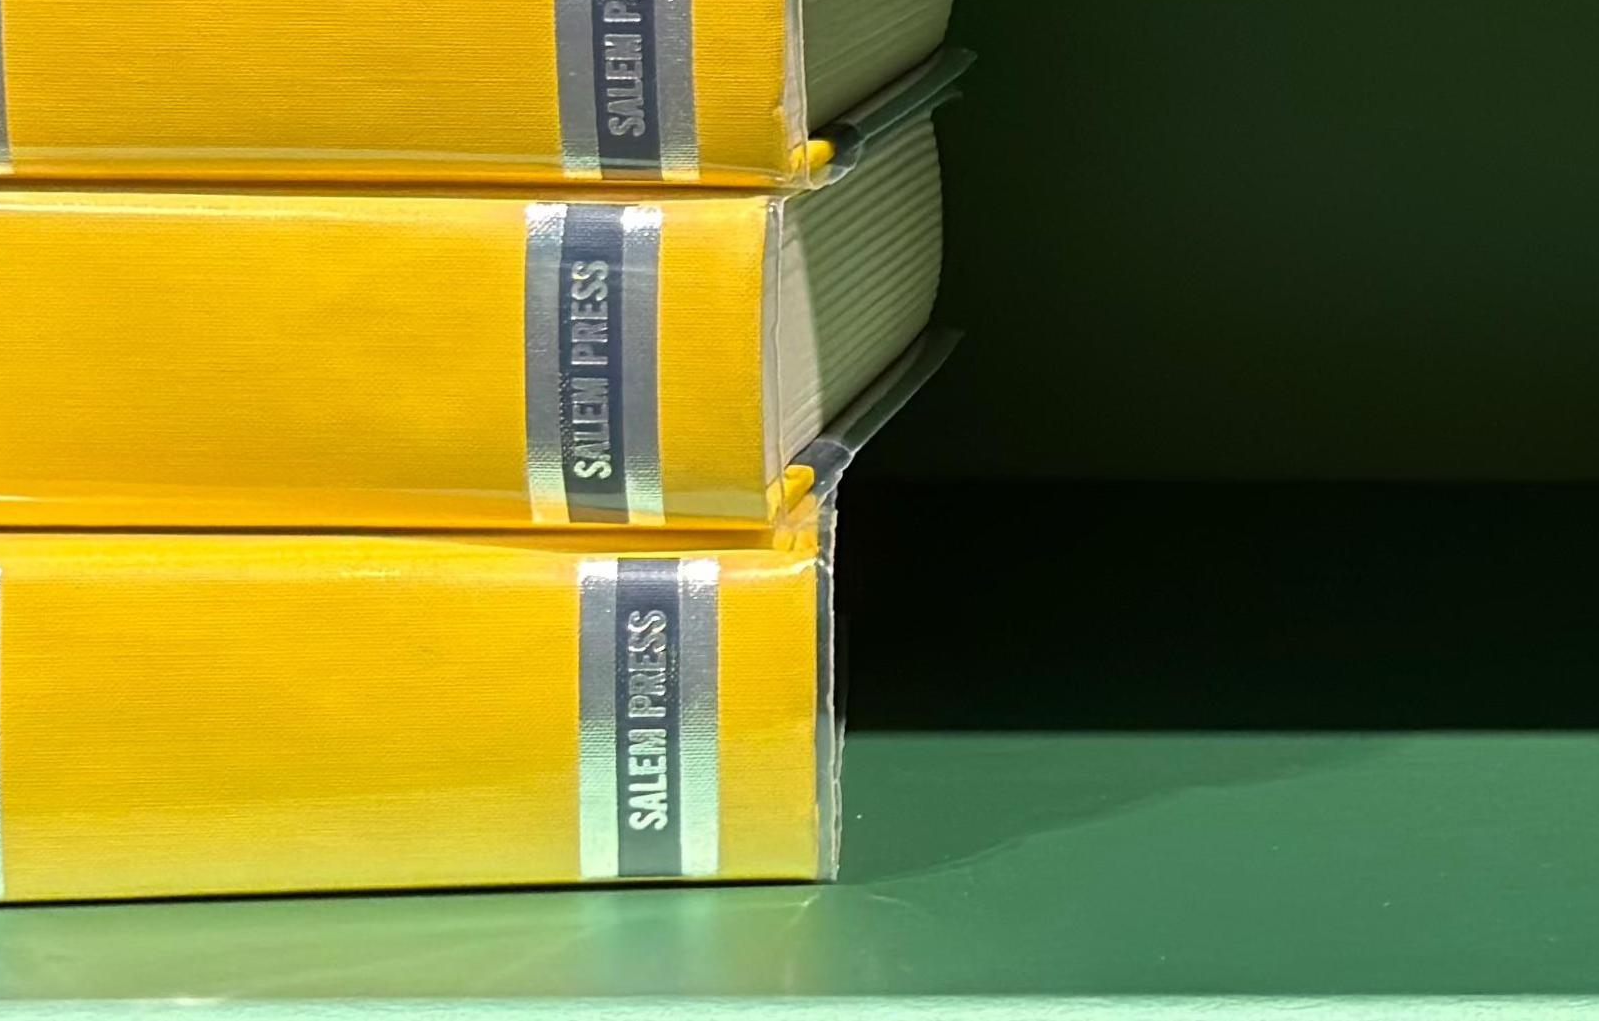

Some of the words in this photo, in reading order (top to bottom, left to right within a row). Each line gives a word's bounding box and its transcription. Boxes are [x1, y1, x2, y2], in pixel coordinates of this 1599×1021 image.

[607, 34, 646, 139] SALEM
[571, 260, 608, 366] PRESS
[572, 378, 612, 479] SALEM
[628, 610, 667, 718] PRESS
[629, 728, 668, 831] SALEM
